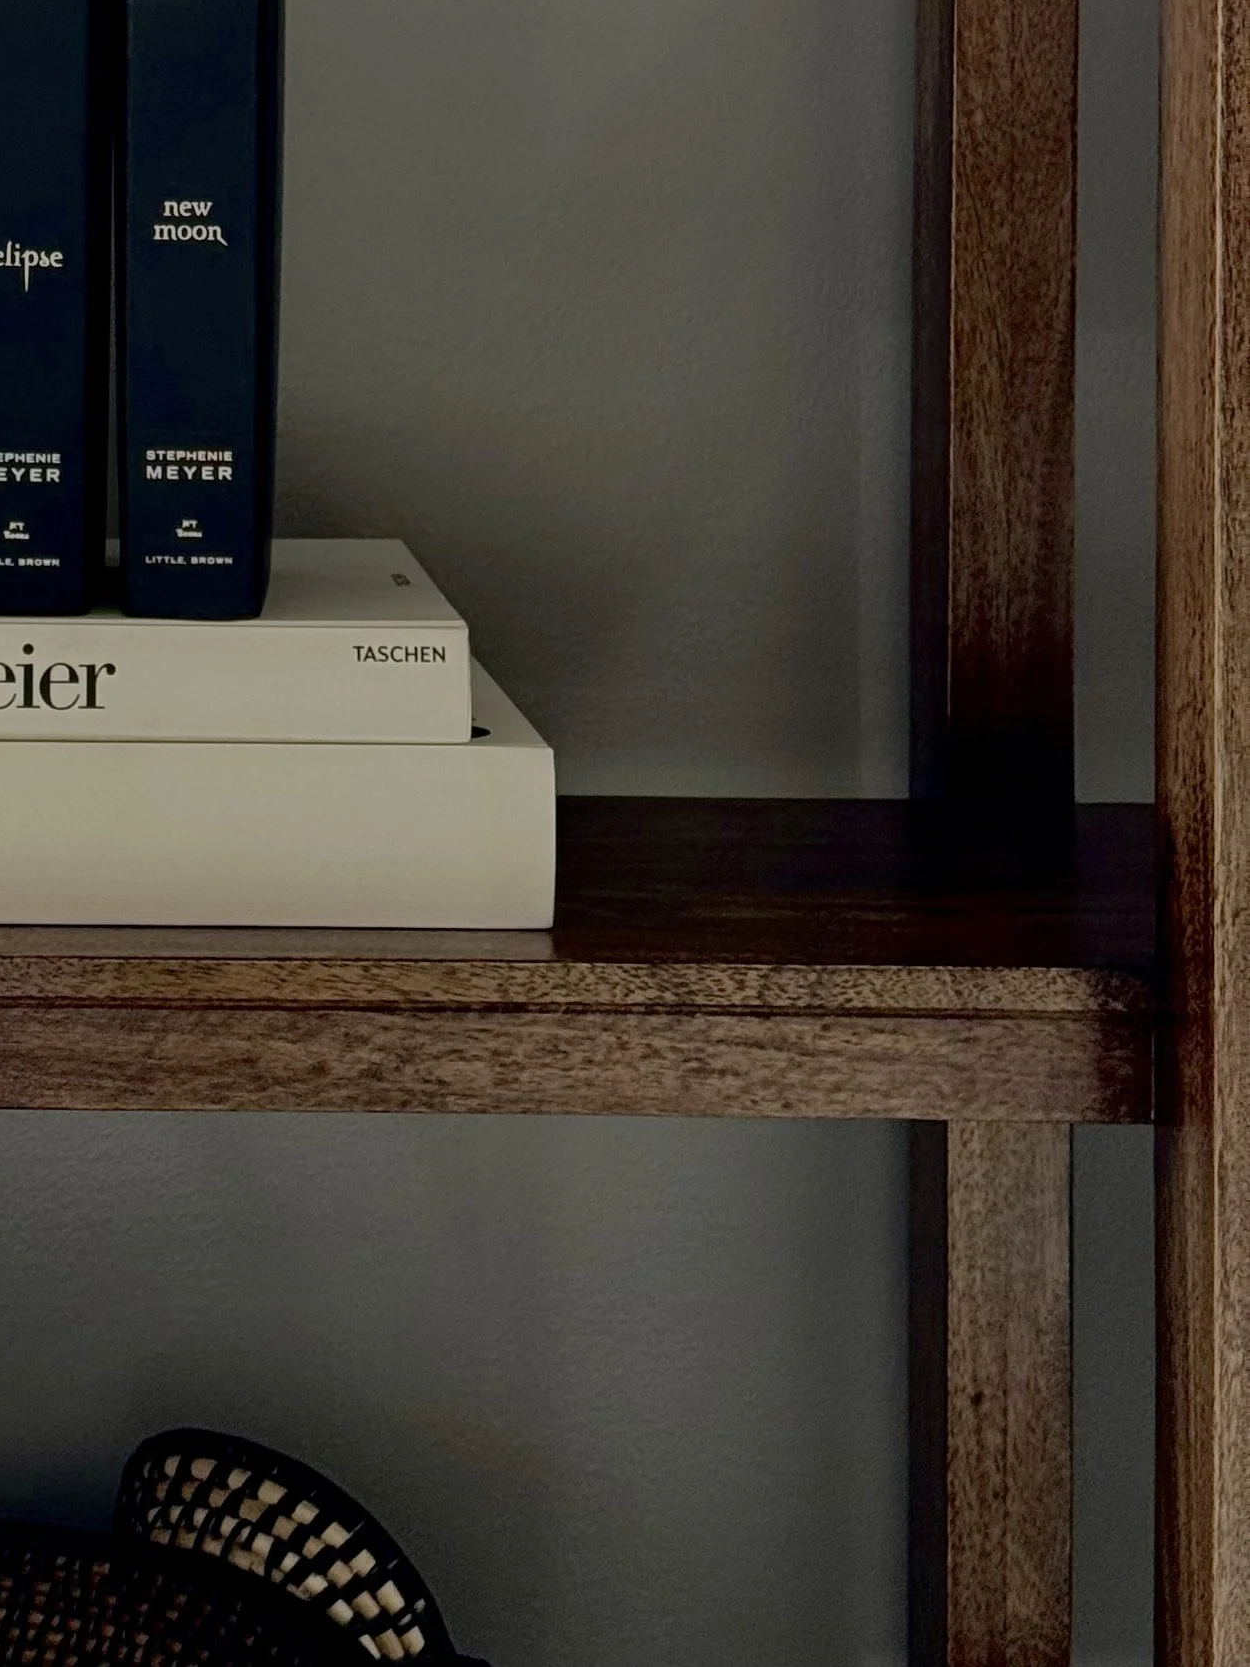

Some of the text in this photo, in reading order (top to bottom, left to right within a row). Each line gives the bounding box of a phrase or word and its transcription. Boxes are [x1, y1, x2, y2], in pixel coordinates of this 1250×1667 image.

[163, 198, 213, 218] new
[153, 220, 228, 247] moon
[145, 449, 233, 462] STEPHENIE
[146, 465, 233, 481] MEYER
[17, 557, 60, 567] BROWN
[190, 555, 233, 565] BROWN
[352, 645, 447, 663] TASCHEN
